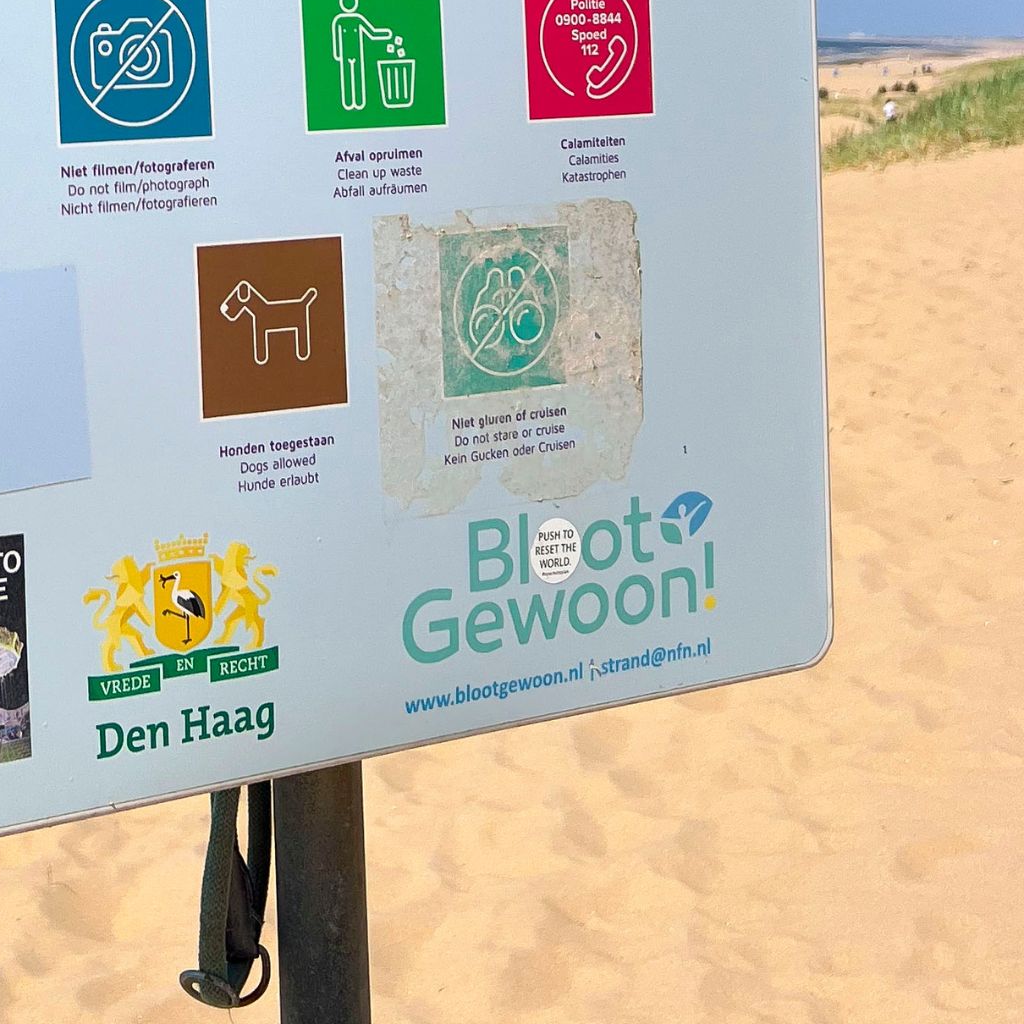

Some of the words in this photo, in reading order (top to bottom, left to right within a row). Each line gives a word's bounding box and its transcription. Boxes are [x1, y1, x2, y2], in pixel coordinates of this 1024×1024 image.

[555, 12, 622, 26] 0900-8844
[571, 28, 607, 43] Spoed
[581, 44, 599, 56] 112
[560, 136, 626, 150] Calamiteiten
[335, 150, 365, 163] Afval
[369, 148, 423, 163] opruimen
[568, 153, 620, 166] Calamities
[60, 165, 88, 179] Niet
[92, 159, 216, 176] filmen/fotograferen
[337, 168, 369, 181] Clean
[372, 169, 387, 180] up
[390, 165, 423, 177] waste
[561, 169, 627, 183] Katastrophen
[67, 184, 86, 197] Do
[89, 183, 110, 196] not
[114, 176, 210, 194] film/photograph
[333, 185, 365, 198] Abfall
[369, 183, 428, 196] aufräumen
[61, 202, 94, 216] Nicht
[97, 195, 218, 213] filmen/fotografieren
[452, 418, 475, 430] Niet
[478, 414, 512, 429] gluren
[515, 409, 527, 422] of
[529, 406, 567, 420] cruisen
[454, 435, 469, 447] Do
[472, 432, 490, 445] not
[493, 430, 519, 442] stare
[521, 428, 533, 438] or
[536, 423, 566, 436] cruise
[219, 442, 266, 458] Honden
[269, 436, 335, 453] toegestaan
[444, 453, 468, 466] Kein
[471, 447, 510, 462] Gucken
[512, 443, 536, 457] oder
[538, 439, 576, 453] Cruisen
[240, 461, 269, 475] Dogs
[272, 453, 317, 470] allowed
[238, 477, 276, 493] Hunde
[280, 472, 320, 488] erlaubt
[468, 495, 655, 593] Blot
[538, 530, 561, 542] PUSH
[562, 528, 574, 540] TO
[535, 543, 559, 556] RESET
[560, 541, 577, 553] THE
[539, 556, 572, 569] WORLD.
[401, 540, 718, 665] Gewoon!
[100, 674, 151, 695] VREDE
[176, 657, 195, 672] EN
[219, 654, 269, 676] RECHT
[405, 661, 584, 714] www.blootgewoon.nl
[600, 637, 712, 675] strand@nfn.nl
[95, 721, 170, 759] Den
[180, 701, 276, 744] Haag
